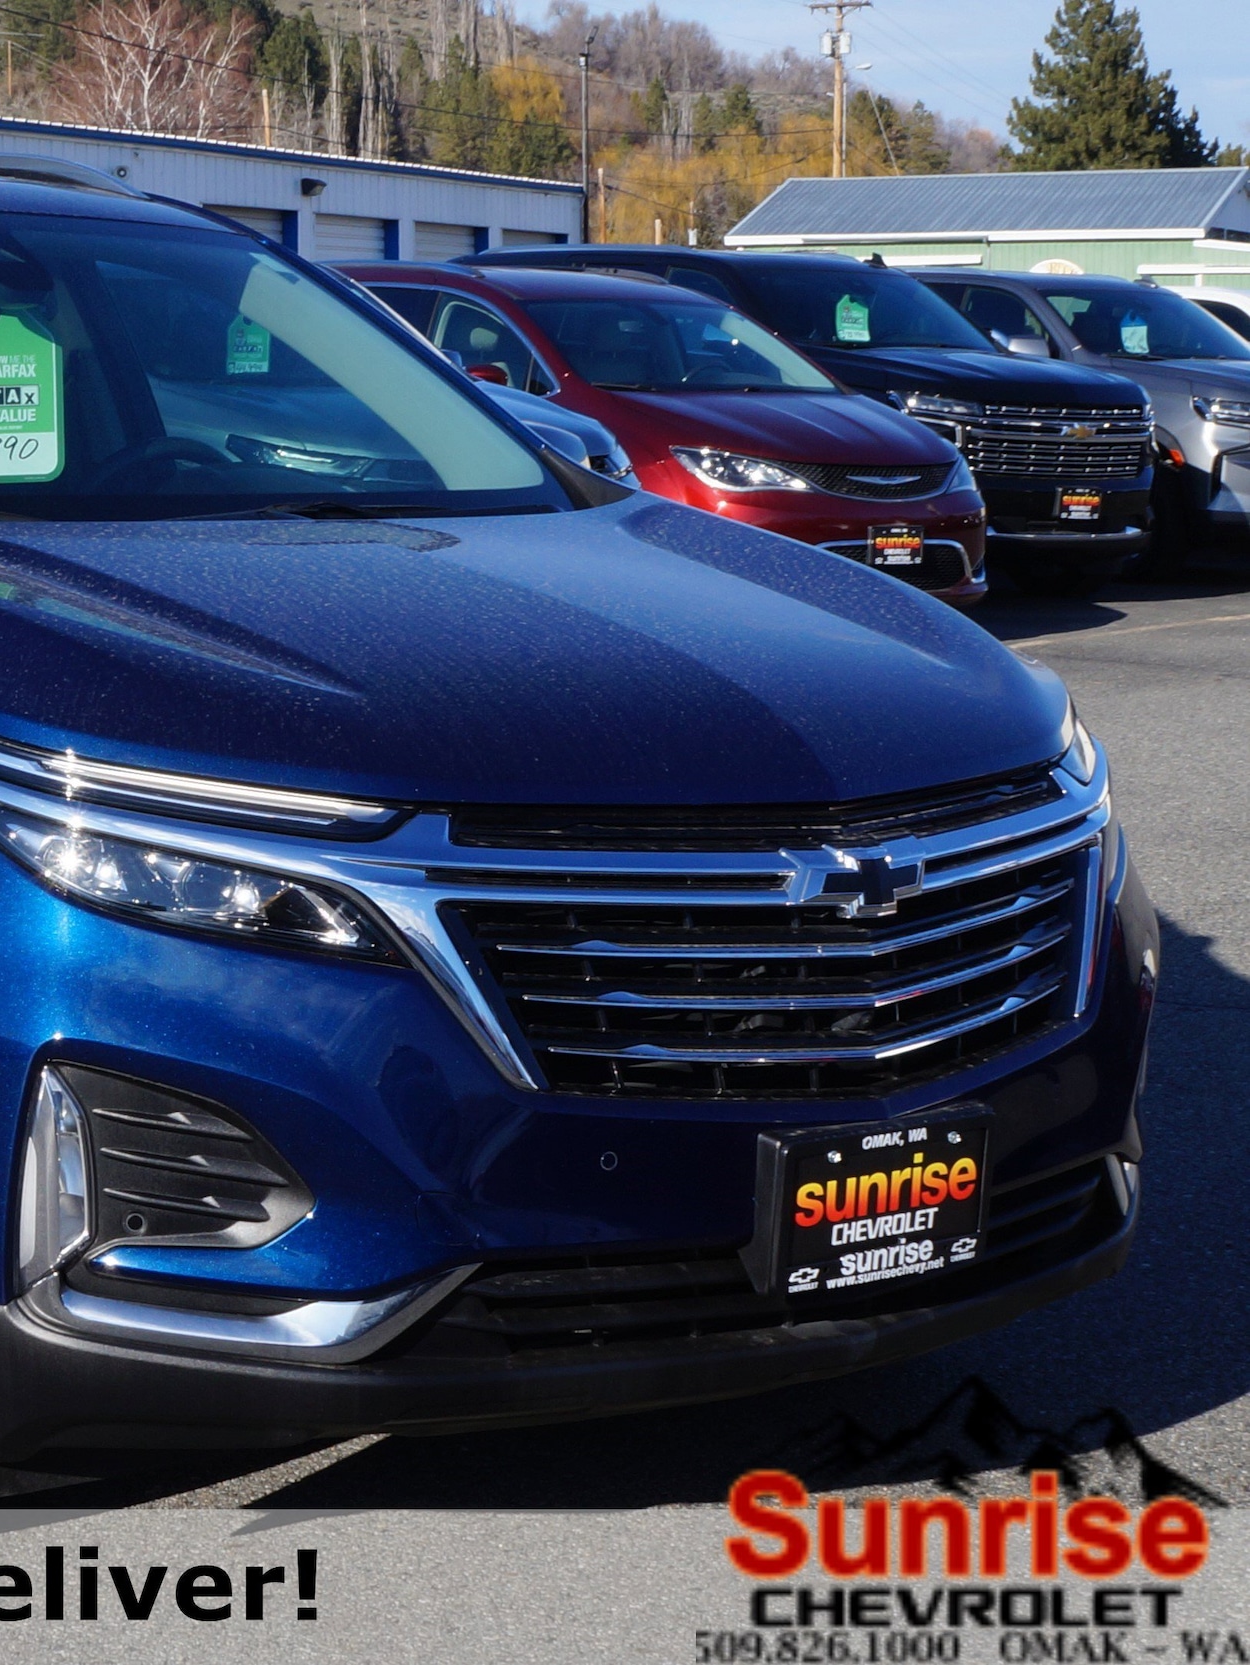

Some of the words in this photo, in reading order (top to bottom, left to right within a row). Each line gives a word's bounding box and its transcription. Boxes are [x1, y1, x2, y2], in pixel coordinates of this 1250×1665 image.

[9, 355, 21, 363] ME
[23, 355, 35, 363] THE
[875, 534, 920, 549] sunrise
[862, 1131, 905, 1150] OMAK,
[908, 1127, 928, 1142] WA
[794, 1152, 978, 1228] sunrise
[831, 1207, 939, 1246] CHEVROLET
[826, 1256, 944, 1290] www.sunrisechevy.net
[840, 1238, 934, 1276] sunrise
